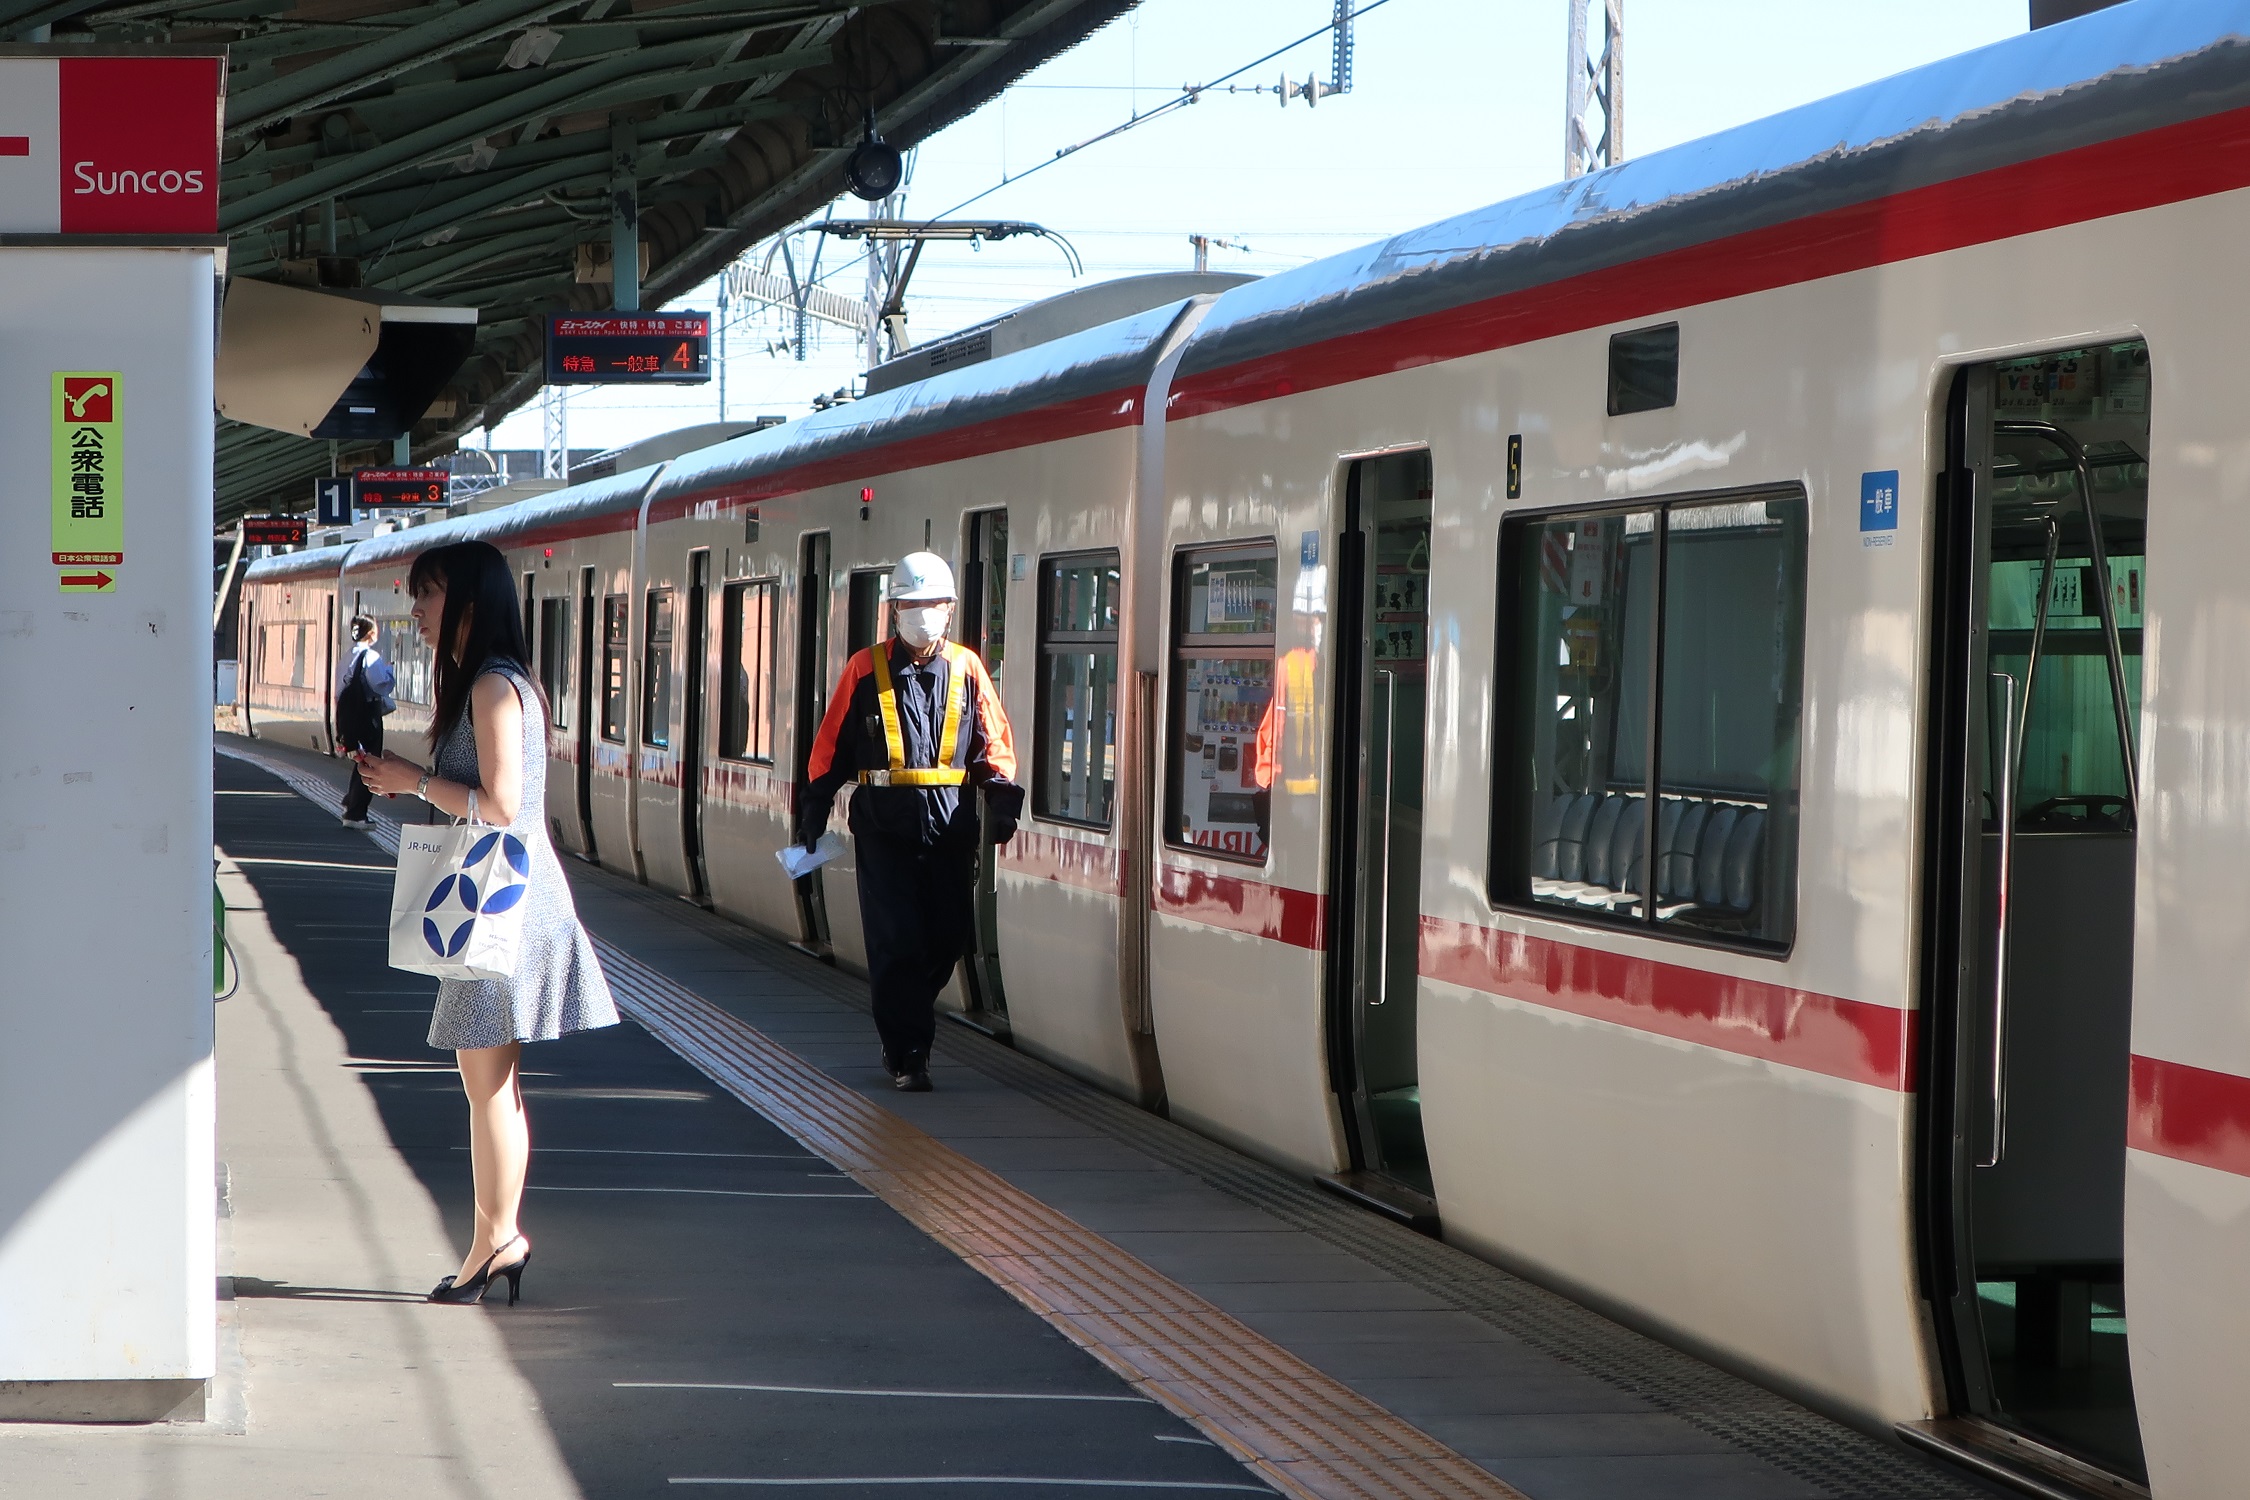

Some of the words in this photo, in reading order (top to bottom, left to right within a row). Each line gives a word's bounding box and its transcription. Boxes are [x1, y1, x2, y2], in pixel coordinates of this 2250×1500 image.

[74, 161, 204, 195] Suncos
[562, 355, 596, 372] 特急
[611, 355, 660, 372] 一般車
[672, 341, 690, 369] 4
[70, 426, 105, 519] 公衆電話
[324, 484, 339, 517] 1
[428, 484, 439, 501] 3
[1866, 487, 1893, 514] 一般車
[291, 529, 300, 541] 2
[58, 554, 117, 563] 日本公衆電話会
[407, 841, 443, 853] JR-PLUS
